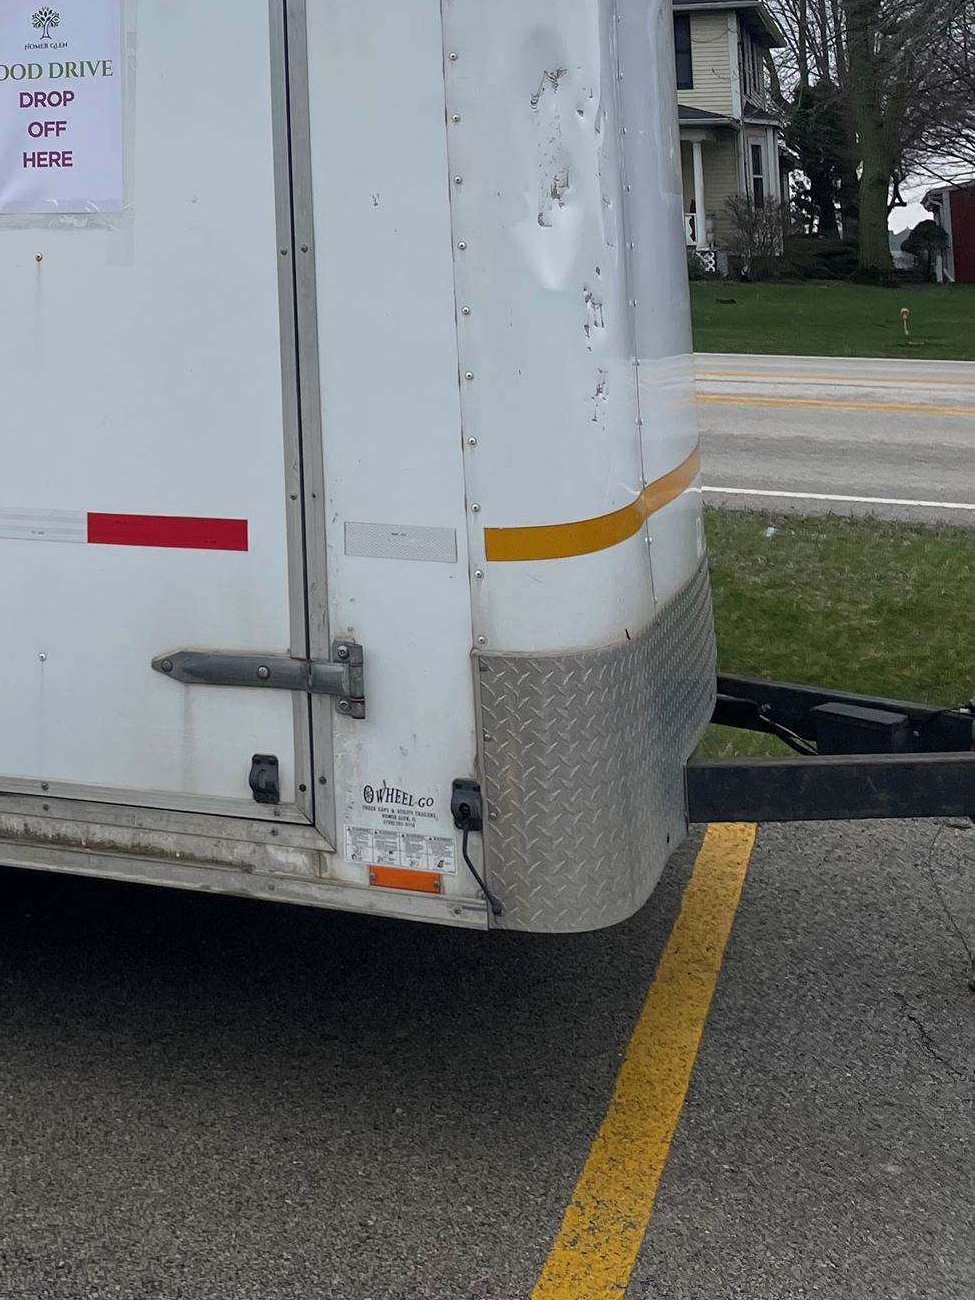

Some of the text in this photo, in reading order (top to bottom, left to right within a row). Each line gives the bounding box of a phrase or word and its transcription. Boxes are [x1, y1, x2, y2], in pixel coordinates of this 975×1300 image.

[24, 41, 68, 51] HOMER GLEN
[48, 59, 113, 79] DRIVE
[19, 90, 75, 108] DROP
[27, 120, 67, 138] OFF
[22, 150, 74, 168] HERE
